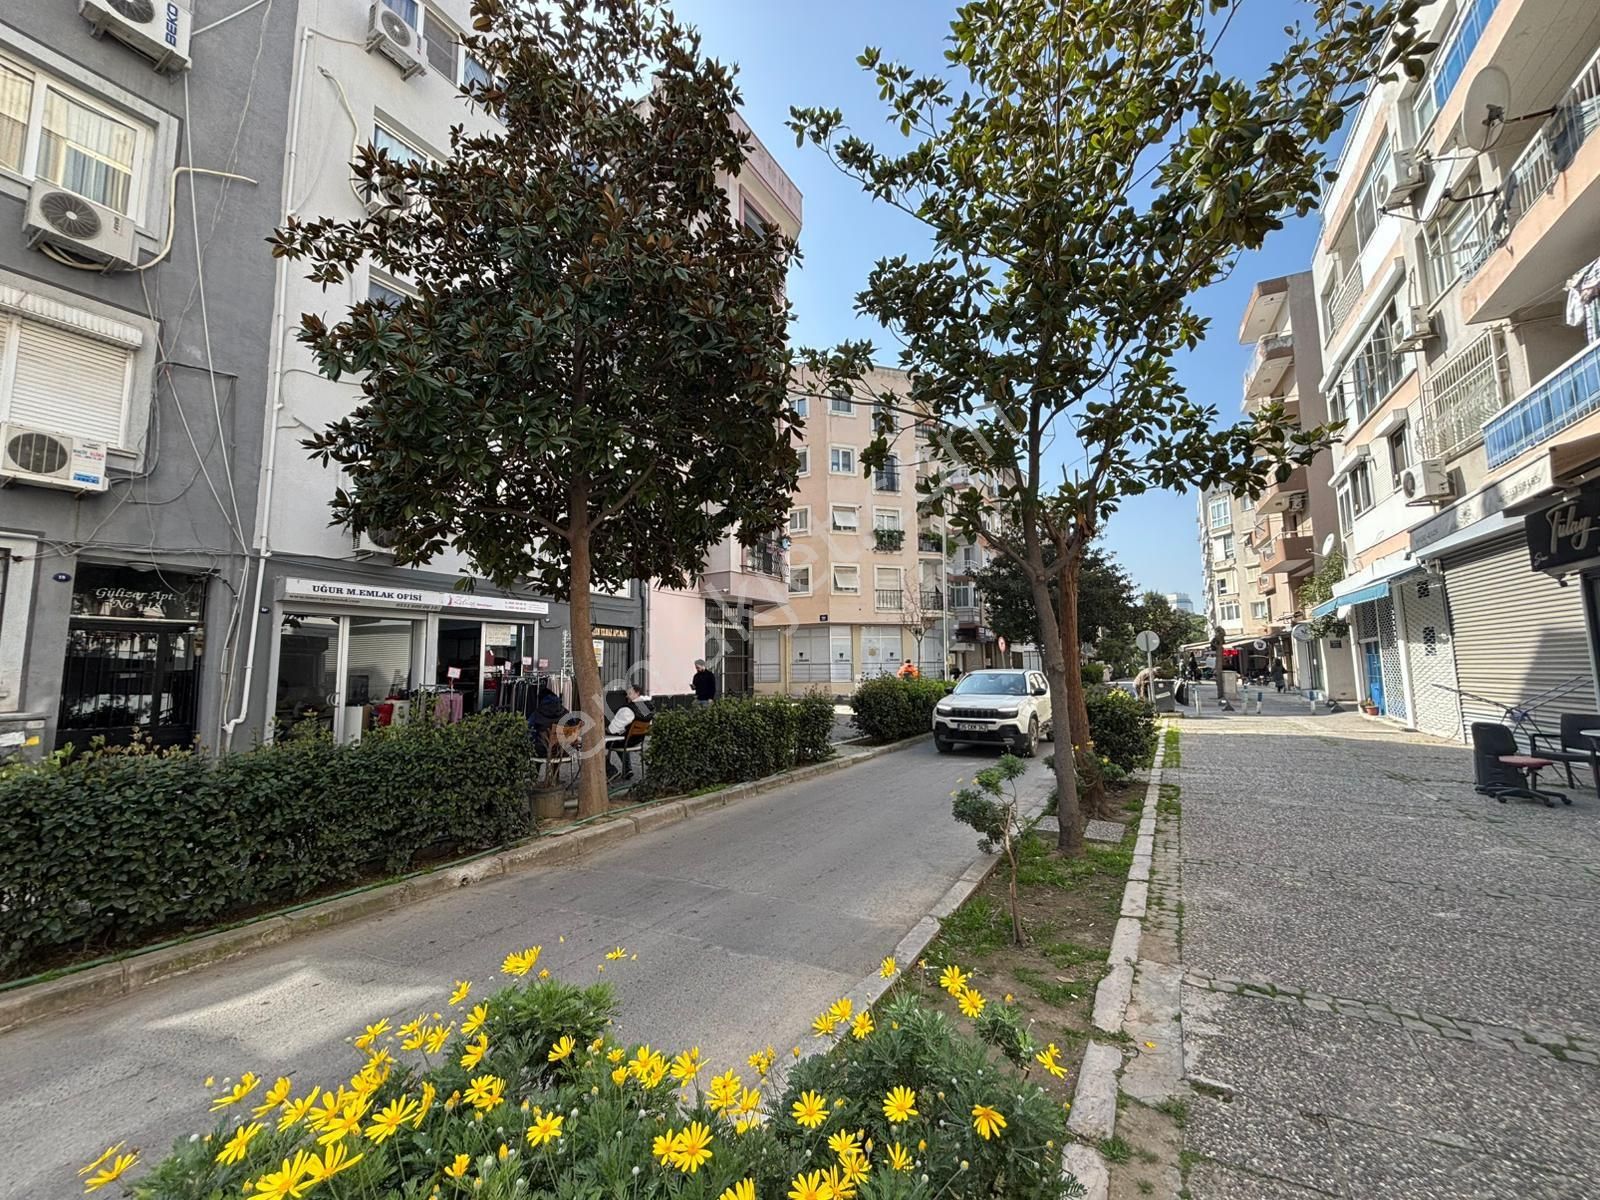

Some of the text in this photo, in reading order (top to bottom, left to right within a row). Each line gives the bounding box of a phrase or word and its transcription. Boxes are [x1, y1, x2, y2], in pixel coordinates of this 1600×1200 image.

[165, 2, 178, 47] BEKO
[95, 587, 177, 601] Gülizar Apt.
[312, 584, 422, 601] UĞUR M.EMLAK OFİSİ
[110, 598, 134, 611] No
